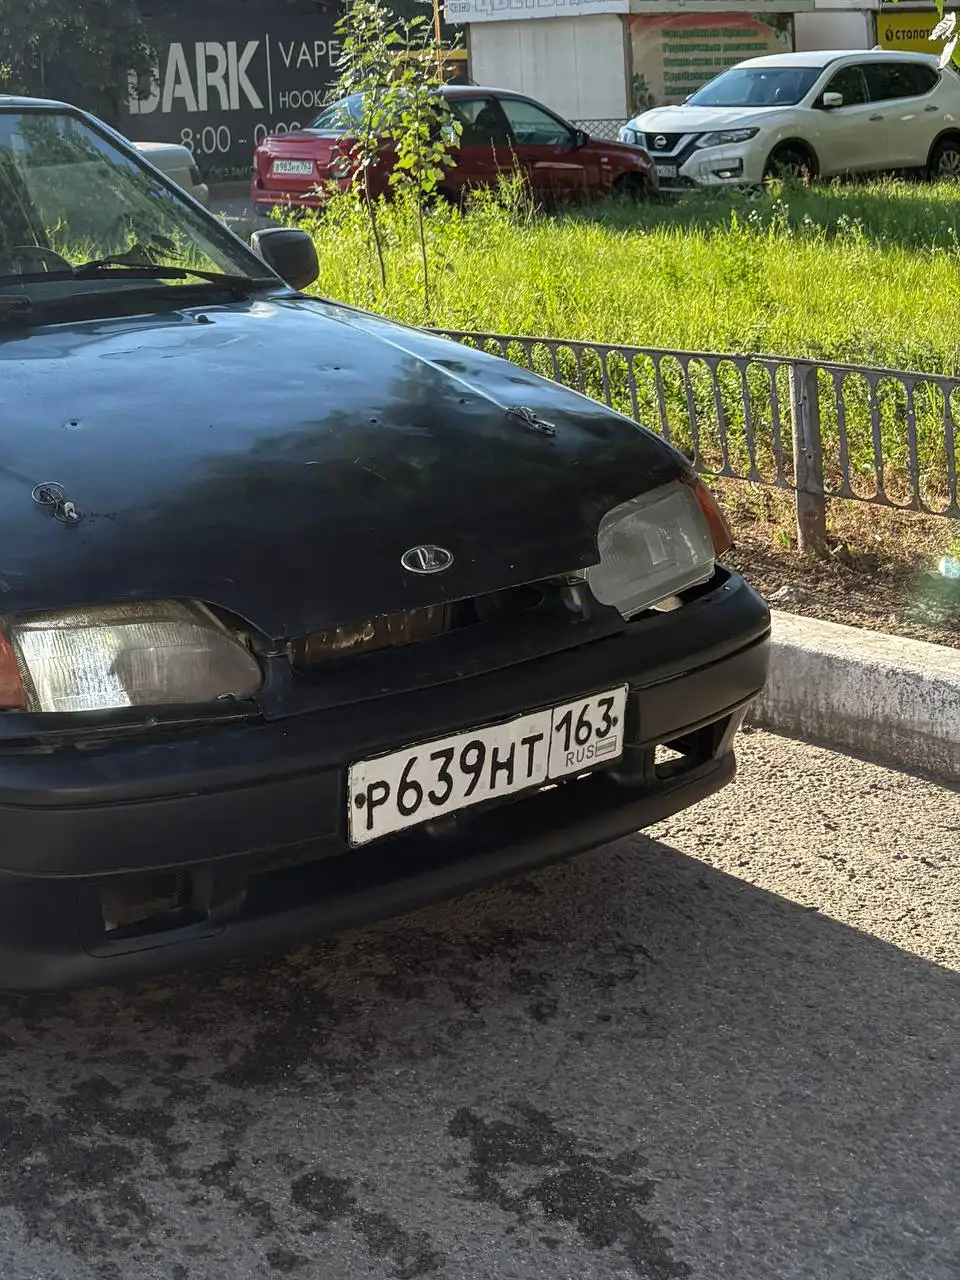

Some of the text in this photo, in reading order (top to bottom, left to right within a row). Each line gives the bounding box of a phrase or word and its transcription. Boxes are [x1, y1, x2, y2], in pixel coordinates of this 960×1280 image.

[895, 28, 934, 40] СТОЛОТ
[365, 697, 615, 830] Р639НТ 163
[565, 745, 595, 768] RUS
